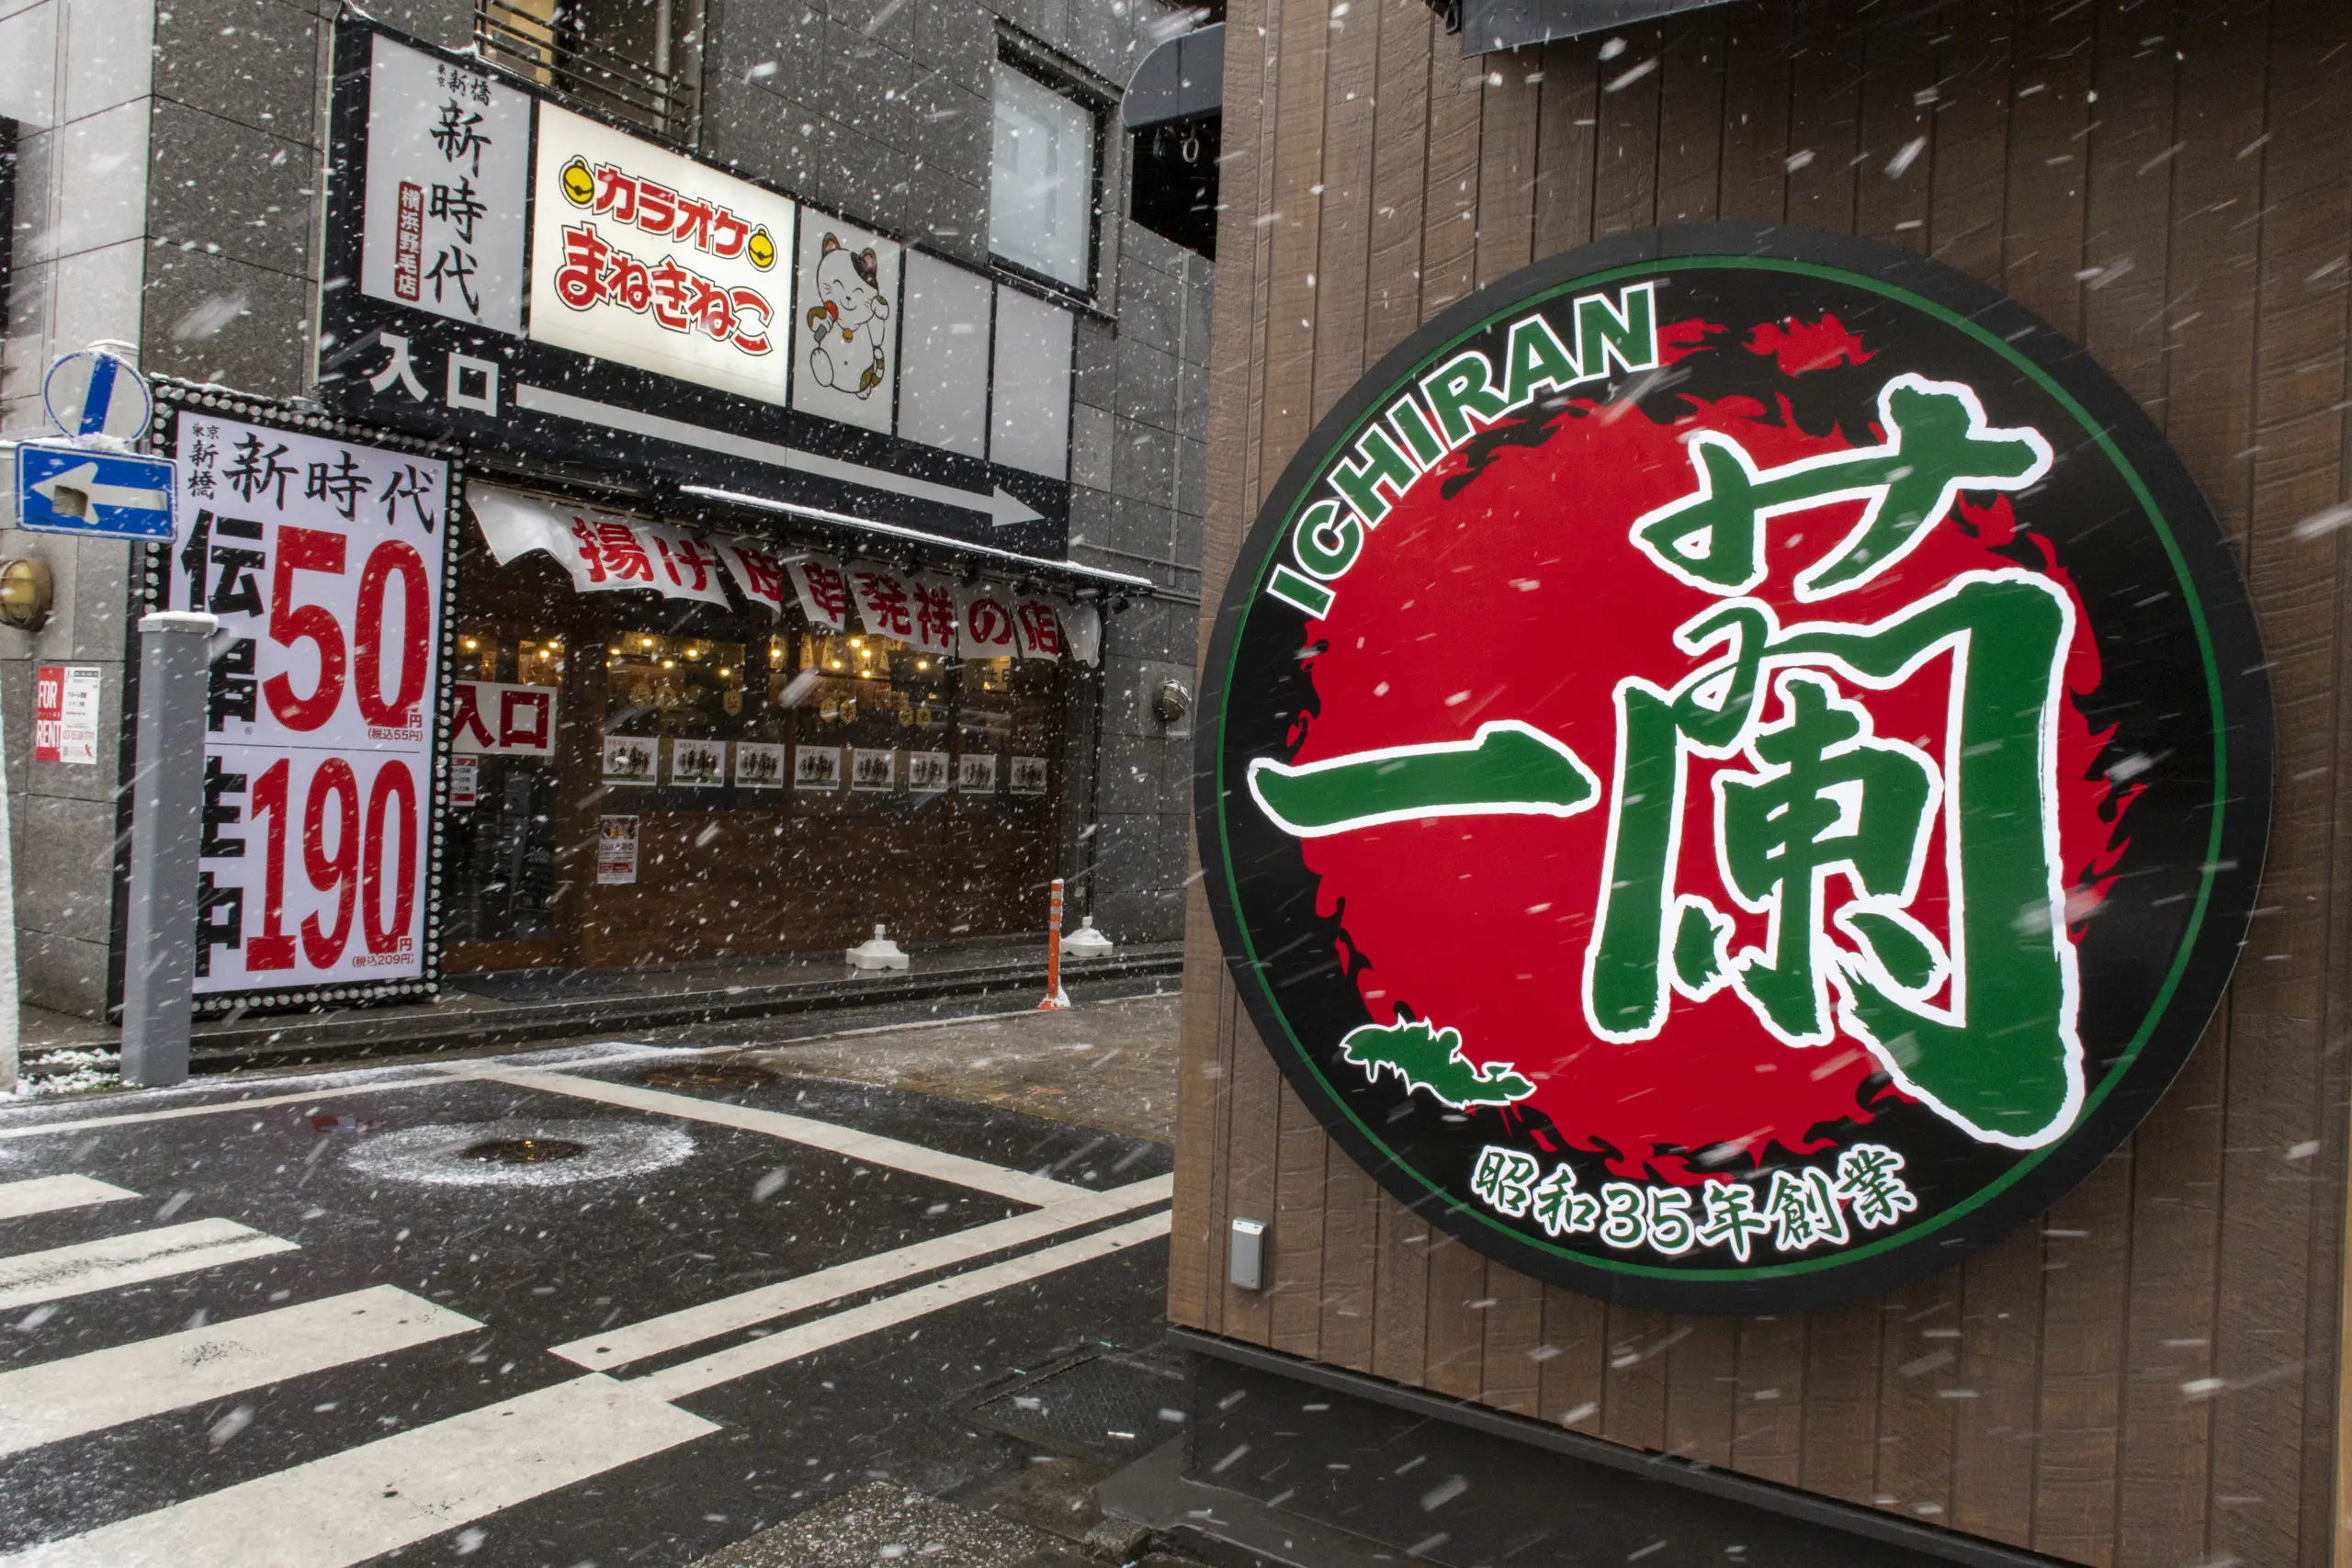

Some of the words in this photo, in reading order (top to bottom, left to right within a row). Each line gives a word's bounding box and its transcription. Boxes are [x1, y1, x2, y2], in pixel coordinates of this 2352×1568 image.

[447, 69, 492, 107] 新橋
[424, 96, 492, 316] 新時代
[594, 163, 752, 260] カラオケ
[554, 221, 774, 356] まねきねこ
[369, 332, 498, 417] 入口
[187, 439, 219, 500] 新橋
[221, 432, 435, 534] 新時代
[1266, 281, 1659, 621] ICHIRAN
[36, 720, 62, 748] RENT
[38, 681, 58, 708] FOR
[451, 684, 549, 749] 入口
[1247, 373, 2086, 1150] 一蘭
[1472, 1145, 1917, 1261] 昭和35年創業
